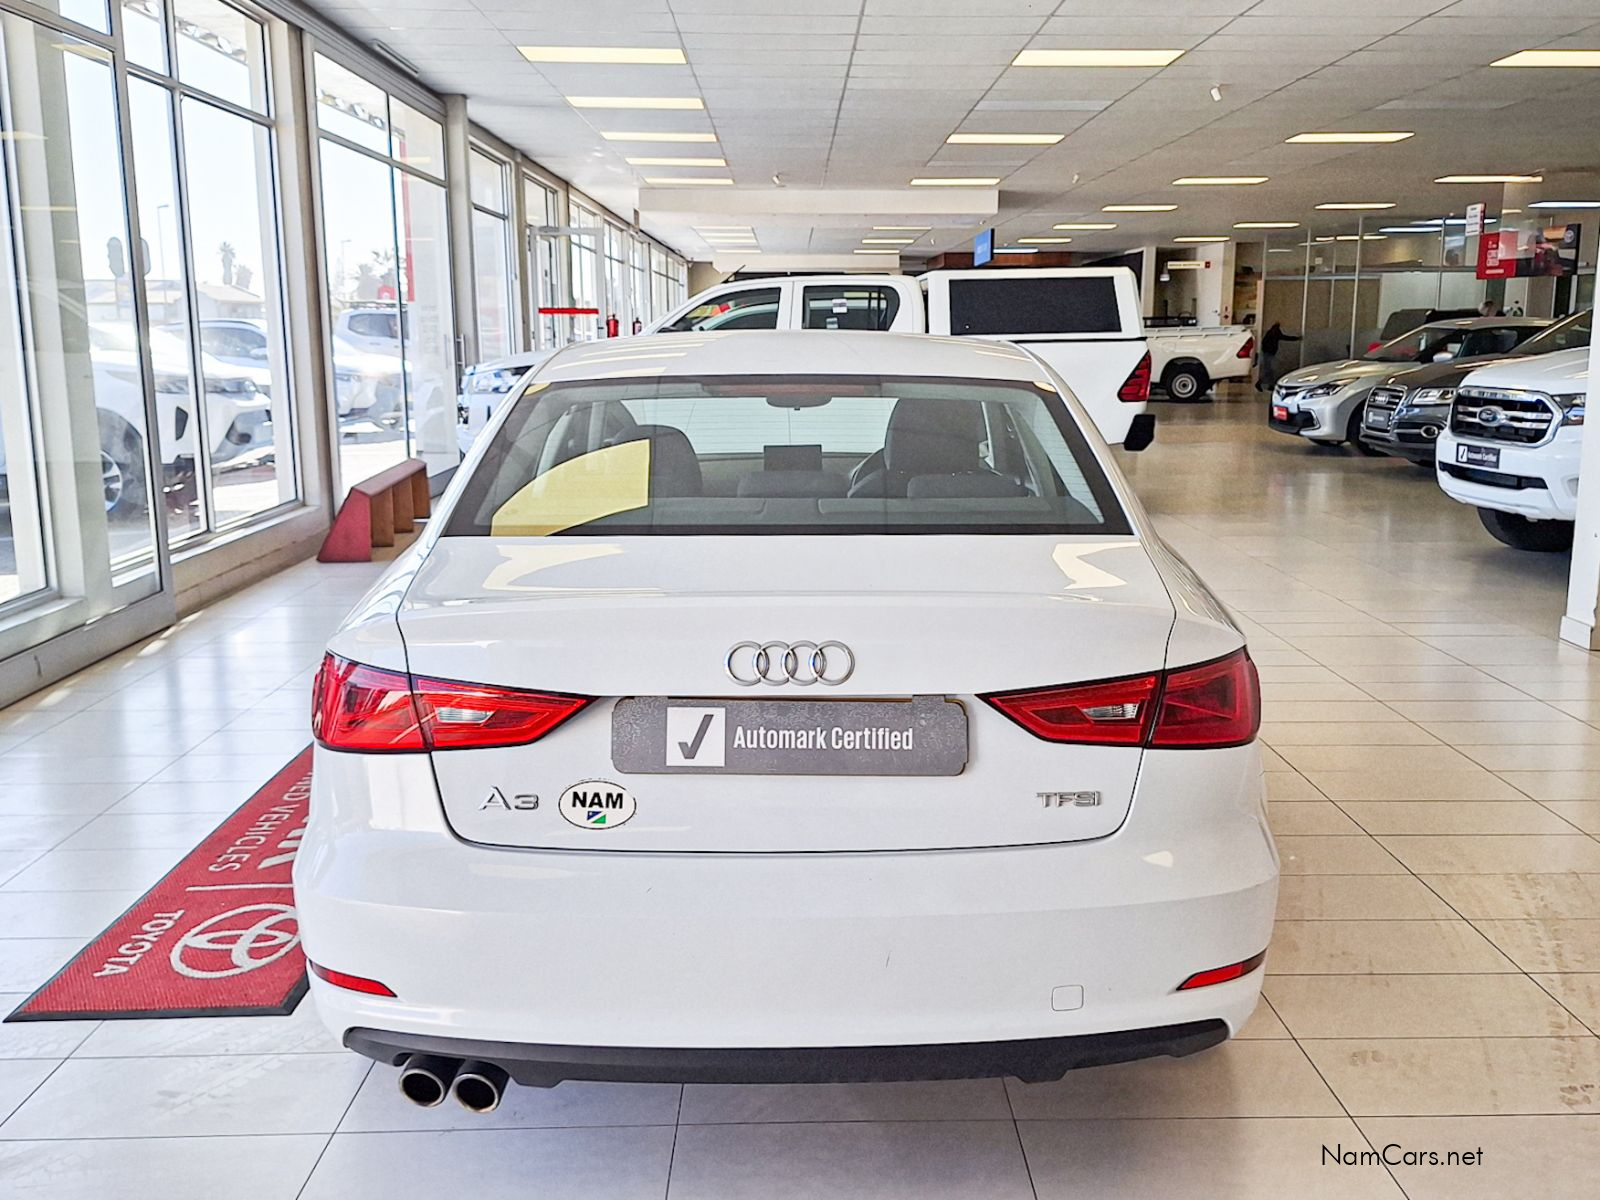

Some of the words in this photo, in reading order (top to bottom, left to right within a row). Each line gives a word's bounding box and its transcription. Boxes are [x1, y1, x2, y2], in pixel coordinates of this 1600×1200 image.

[733, 726, 828, 749] Automark
[831, 726, 914, 750] Certified
[478, 786, 540, 811] A3
[571, 791, 624, 809] NAM
[208, 803, 300, 872] VEHICLES
[93, 909, 185, 977] TOYOTA
